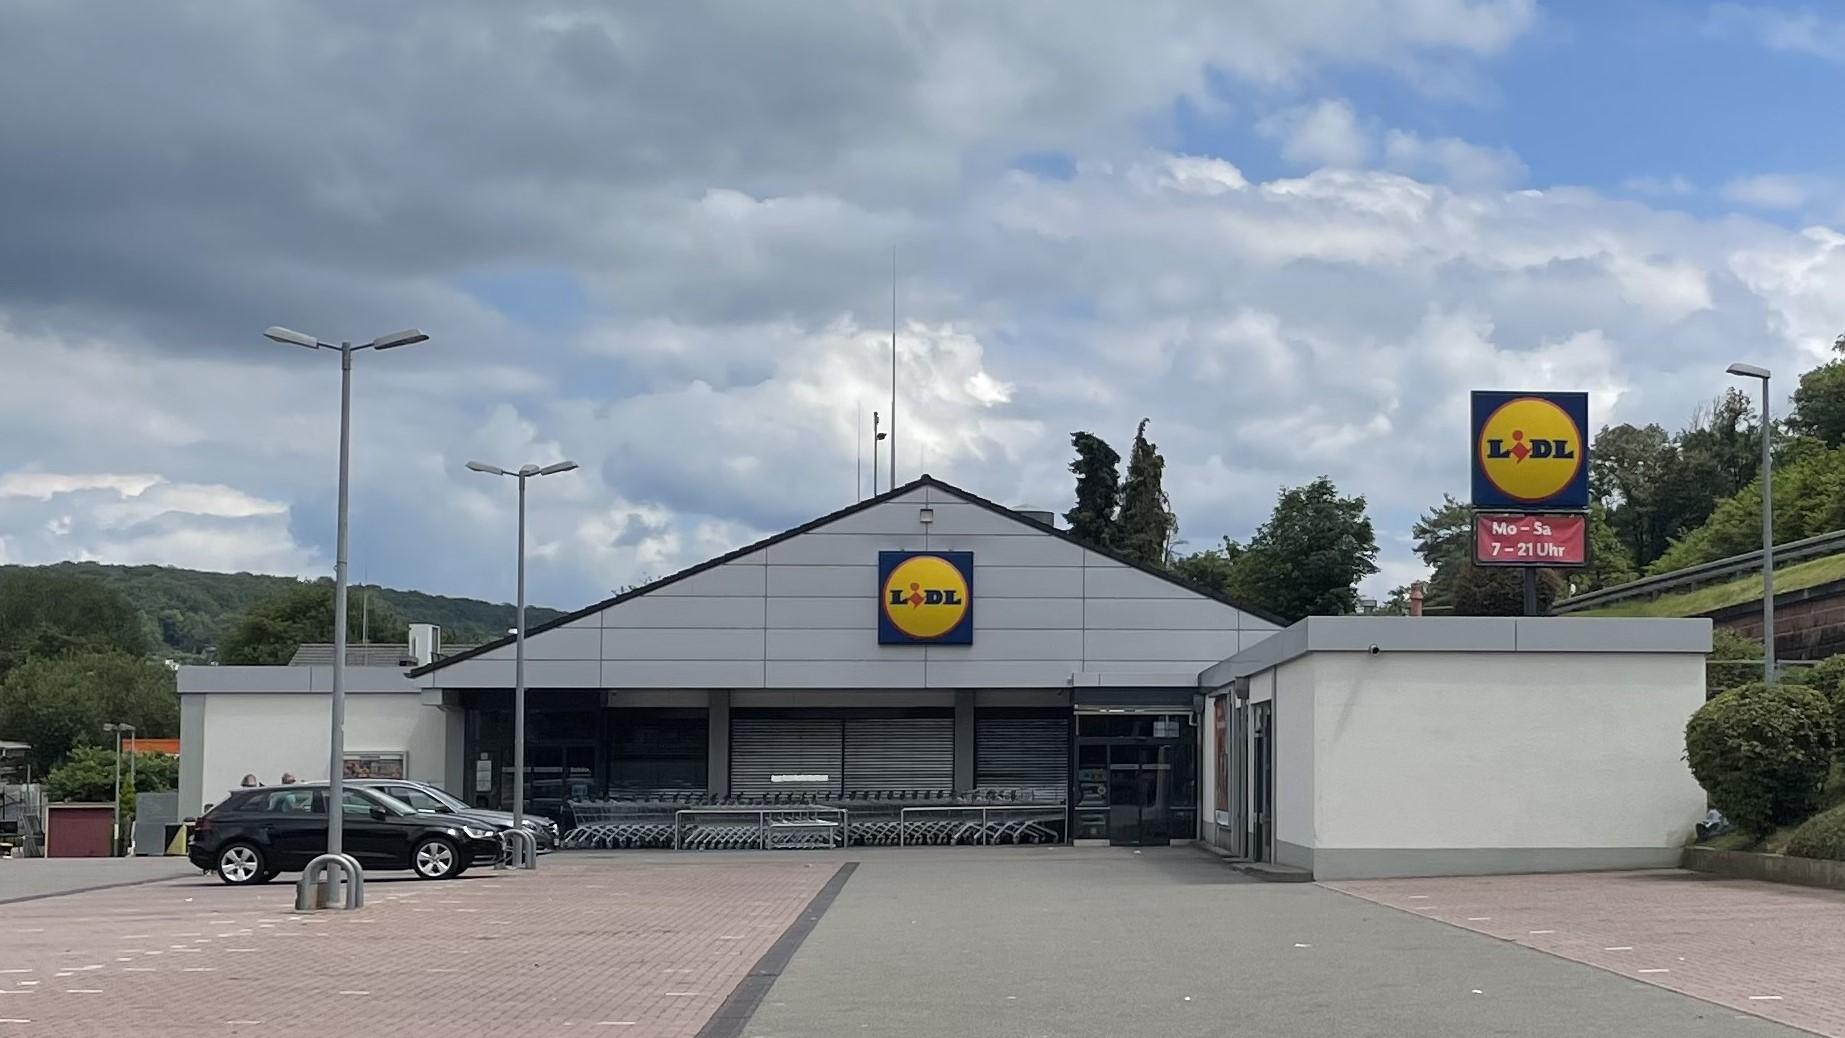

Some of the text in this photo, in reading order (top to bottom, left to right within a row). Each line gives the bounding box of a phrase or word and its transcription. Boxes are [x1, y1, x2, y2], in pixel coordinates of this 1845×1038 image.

[1492, 521, 1517, 535] Mo
[1533, 521, 1552, 535] Sa
[1491, 542, 1501, 556] 7
[1517, 542, 1533, 556] 21
[1536, 542, 1565, 557] Uhr
